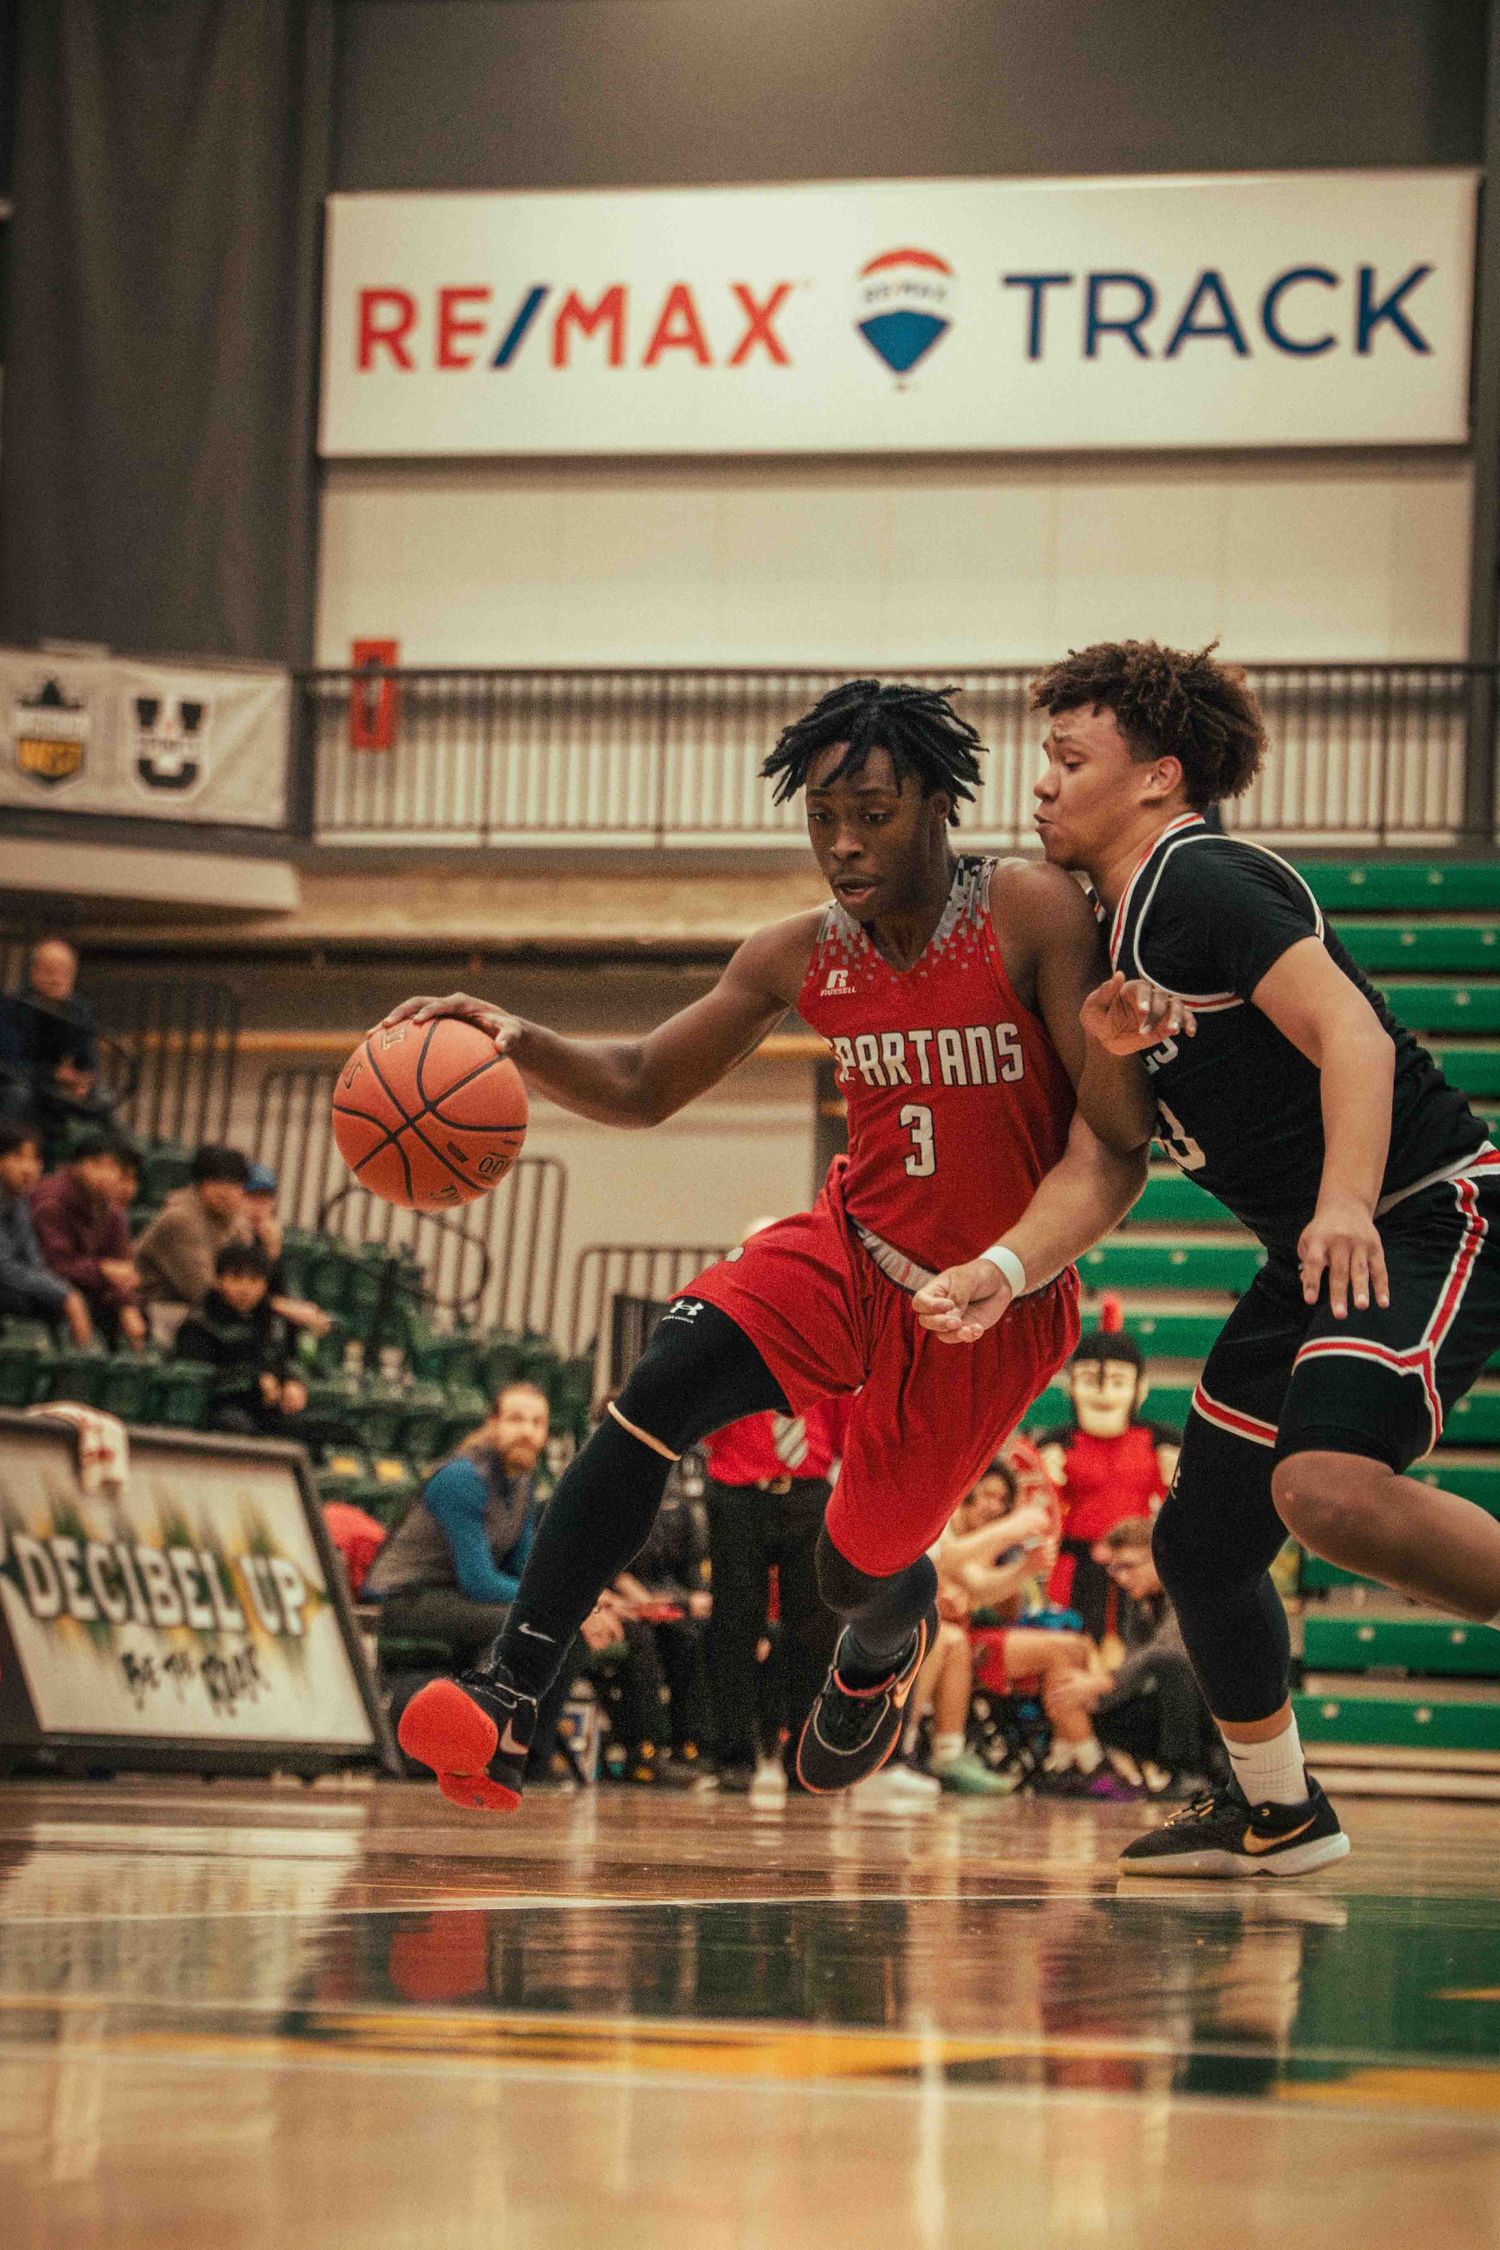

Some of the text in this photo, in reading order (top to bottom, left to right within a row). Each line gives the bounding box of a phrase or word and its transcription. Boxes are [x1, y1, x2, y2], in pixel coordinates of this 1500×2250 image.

[354, 263, 1435, 372] RE/MAX TRACK
[829, 1022, 1025, 1086] PARTANS
[900, 1103, 937, 1178] 3
[11, 1534, 306, 1637] DECIBEL UP
